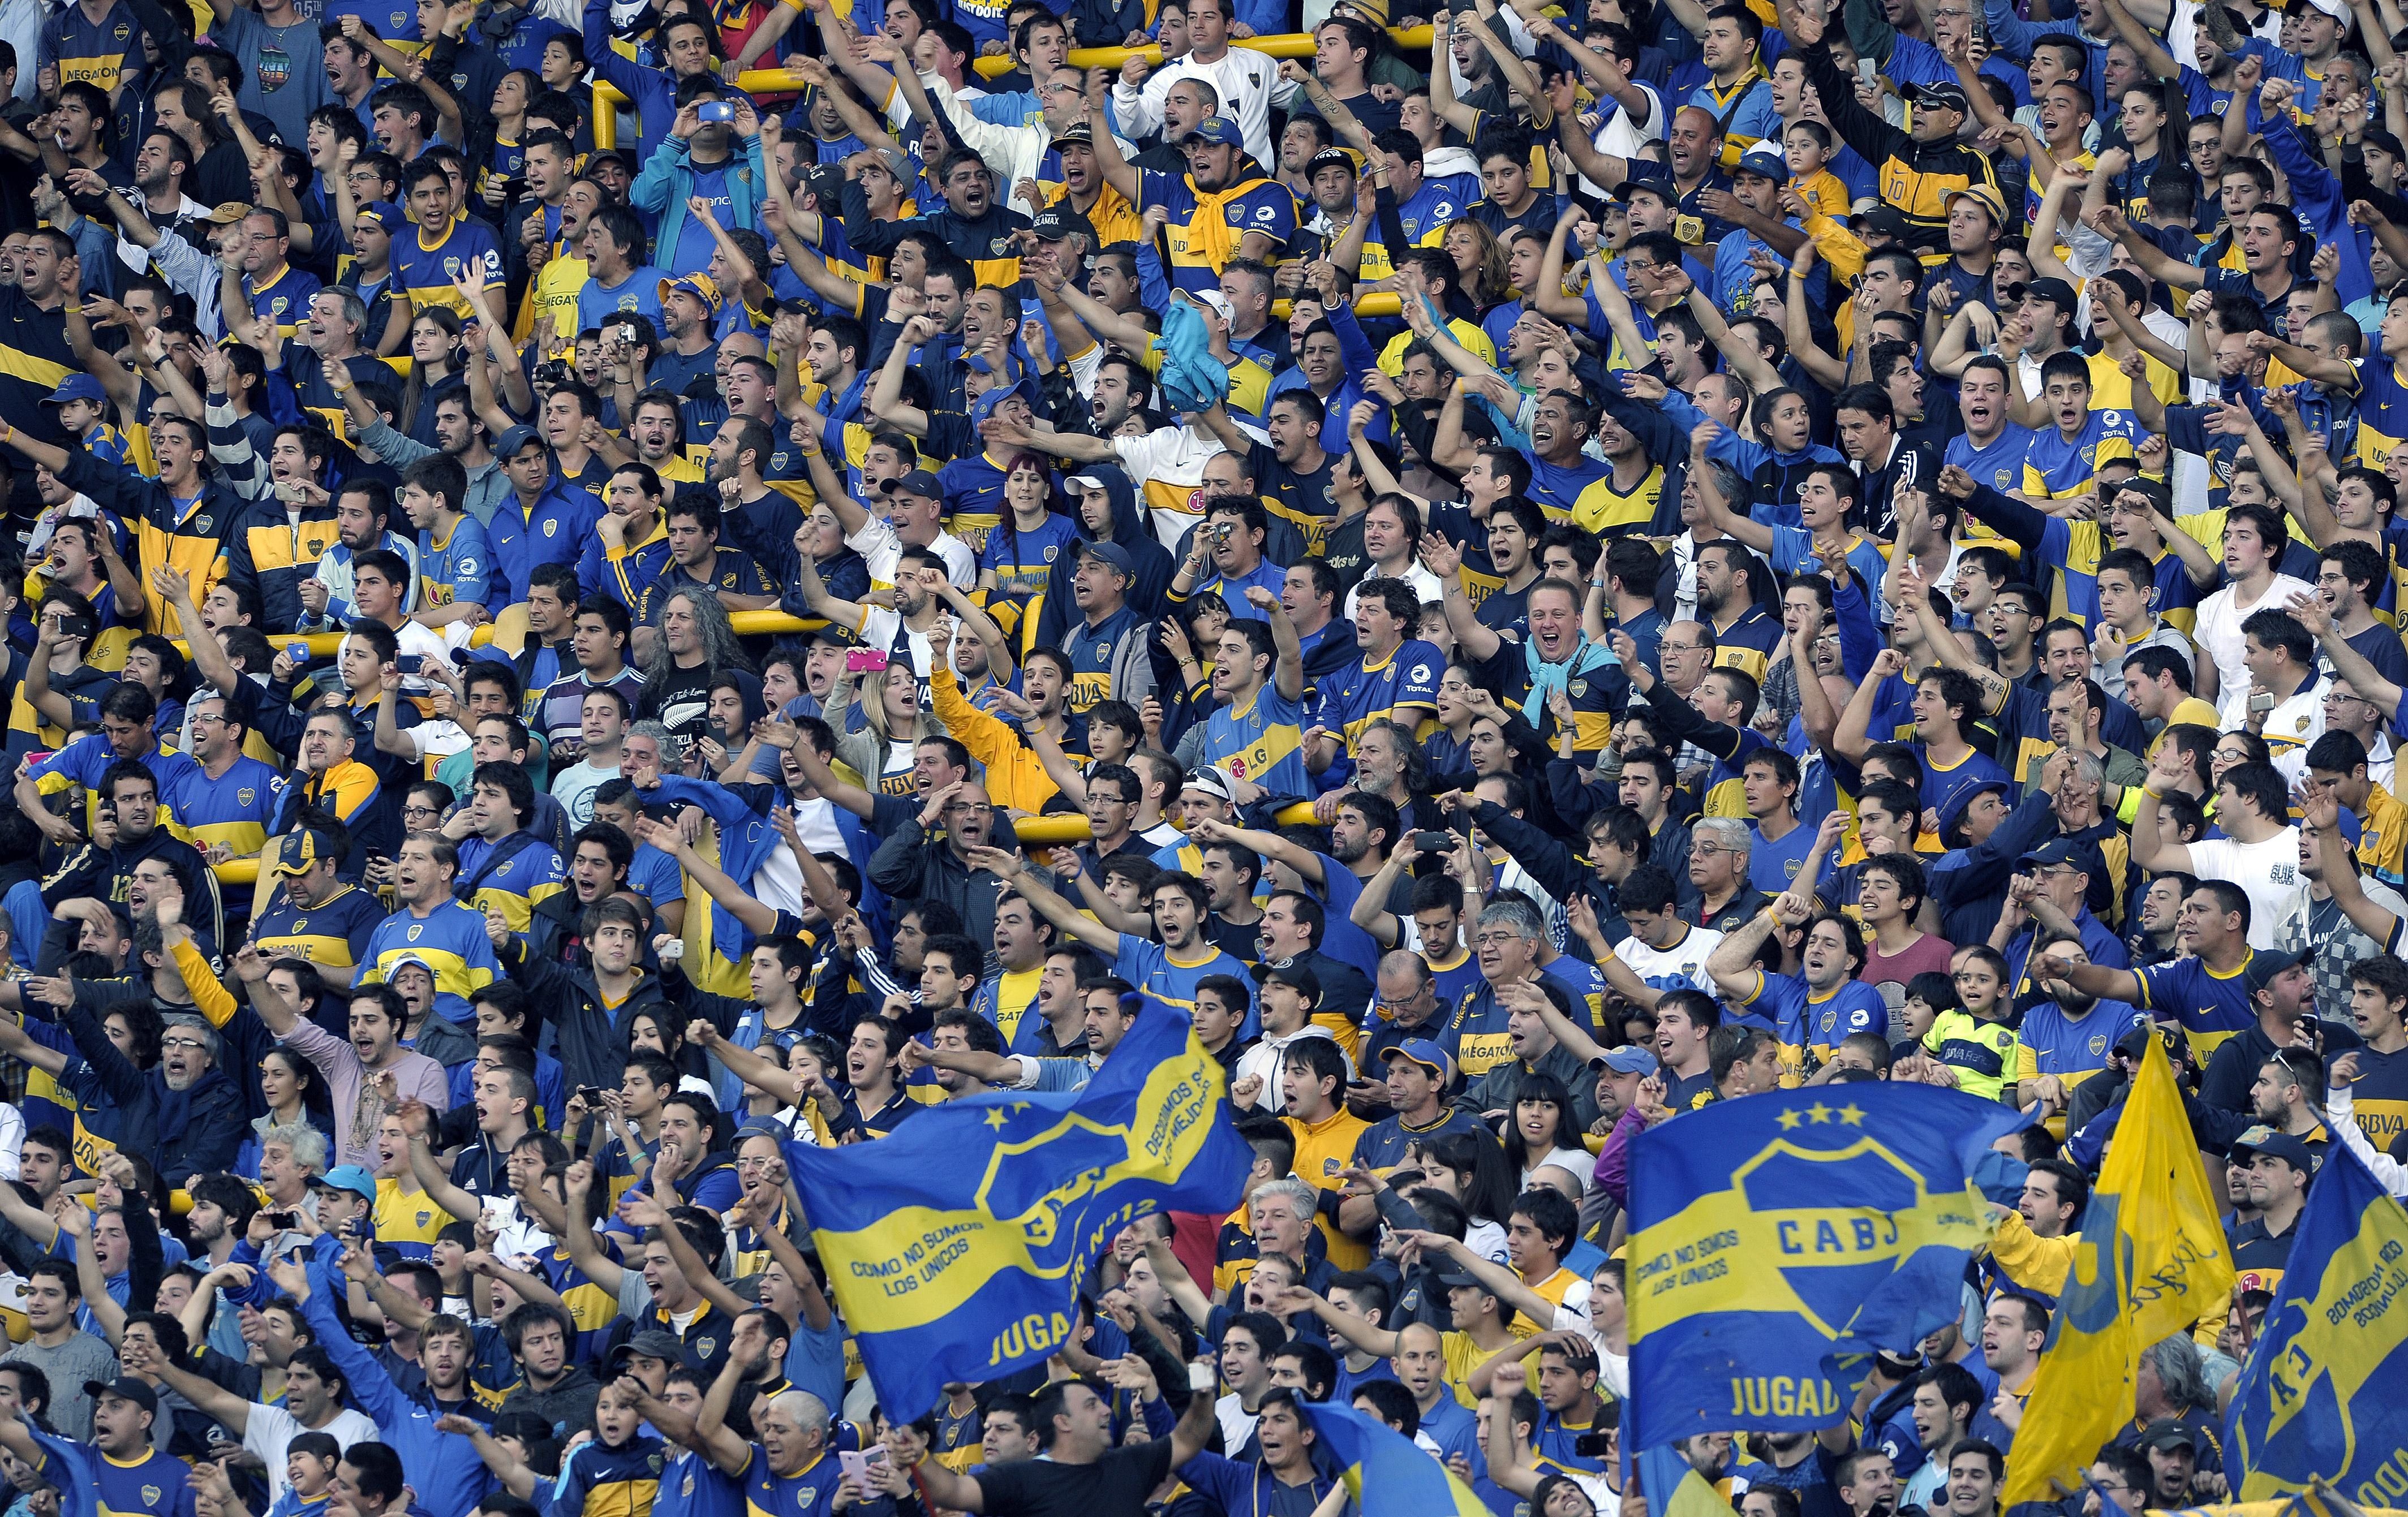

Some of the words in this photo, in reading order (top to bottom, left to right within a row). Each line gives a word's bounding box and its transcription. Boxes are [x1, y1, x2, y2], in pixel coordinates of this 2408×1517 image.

[1887, 178, 1904, 201] 10
[1250, 221, 1274, 232] TOTAL
[797, 299, 819, 316] BJ
[2101, 429, 2127, 438] TOTAL
[455, 576, 480, 585] TOTAL
[753, 561, 771, 584] unicef
[836, 626, 857, 645] BJ
[1405, 686, 1434, 695] TOTAL
[1247, 748, 1268, 770] LG
[109, 874, 132, 902] 12
[2270, 872, 2294, 882] QUIK
[2355, 1113, 2405, 1135] BBVA
[1777, 1212, 1898, 1255] CABJ
[850, 1260, 902, 1286] COMO
[904, 1240, 926, 1271] NO
[883, 1273, 919, 1298] LOS
[922, 1238, 969, 1283] UNICOS
